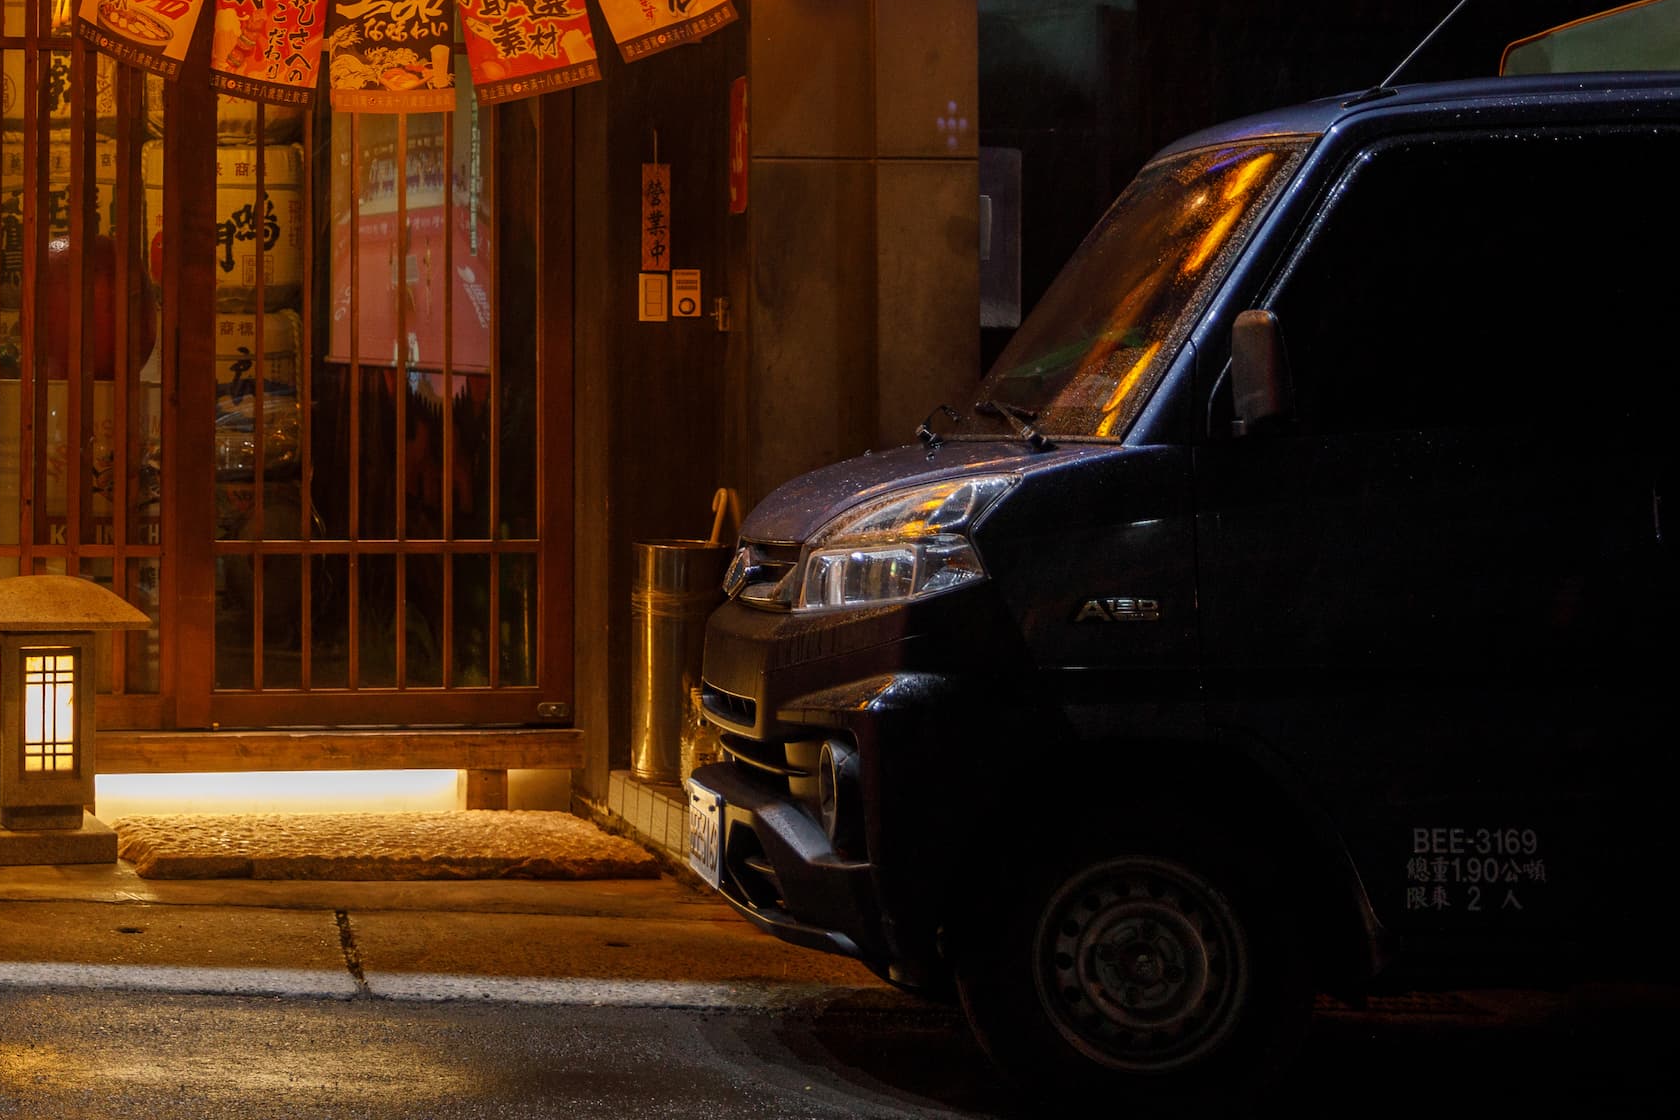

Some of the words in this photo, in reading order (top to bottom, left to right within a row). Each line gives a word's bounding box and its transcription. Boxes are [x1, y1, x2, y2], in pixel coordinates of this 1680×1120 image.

[492, 16, 559, 59] 素材
[1413, 827, 1538, 855] BEE-3169
[1466, 885, 1482, 912] 2
[1501, 888, 1524, 911] 人
